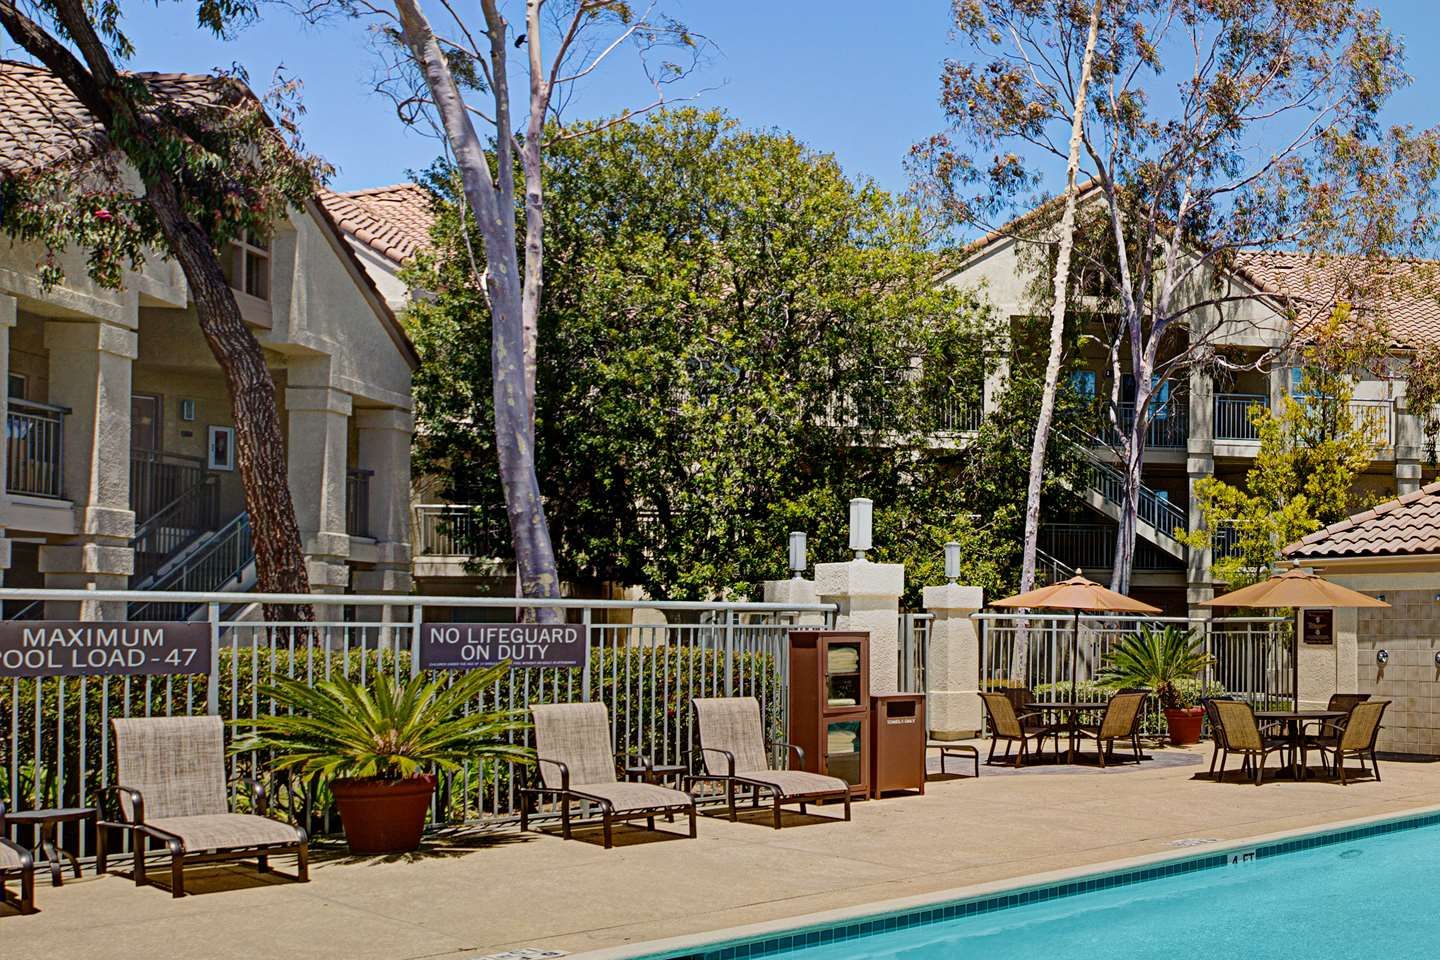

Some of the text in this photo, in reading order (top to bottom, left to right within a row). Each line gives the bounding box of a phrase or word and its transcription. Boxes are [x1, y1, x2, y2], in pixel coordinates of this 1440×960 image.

[23, 628, 164, 648] MAXIMUM
[430, 628, 577, 644] NO LIFEGUARD
[0, 649, 63, 669] OOL
[461, 644, 549, 661] ON DUTY
[1243, 852, 1255, 862] FT
